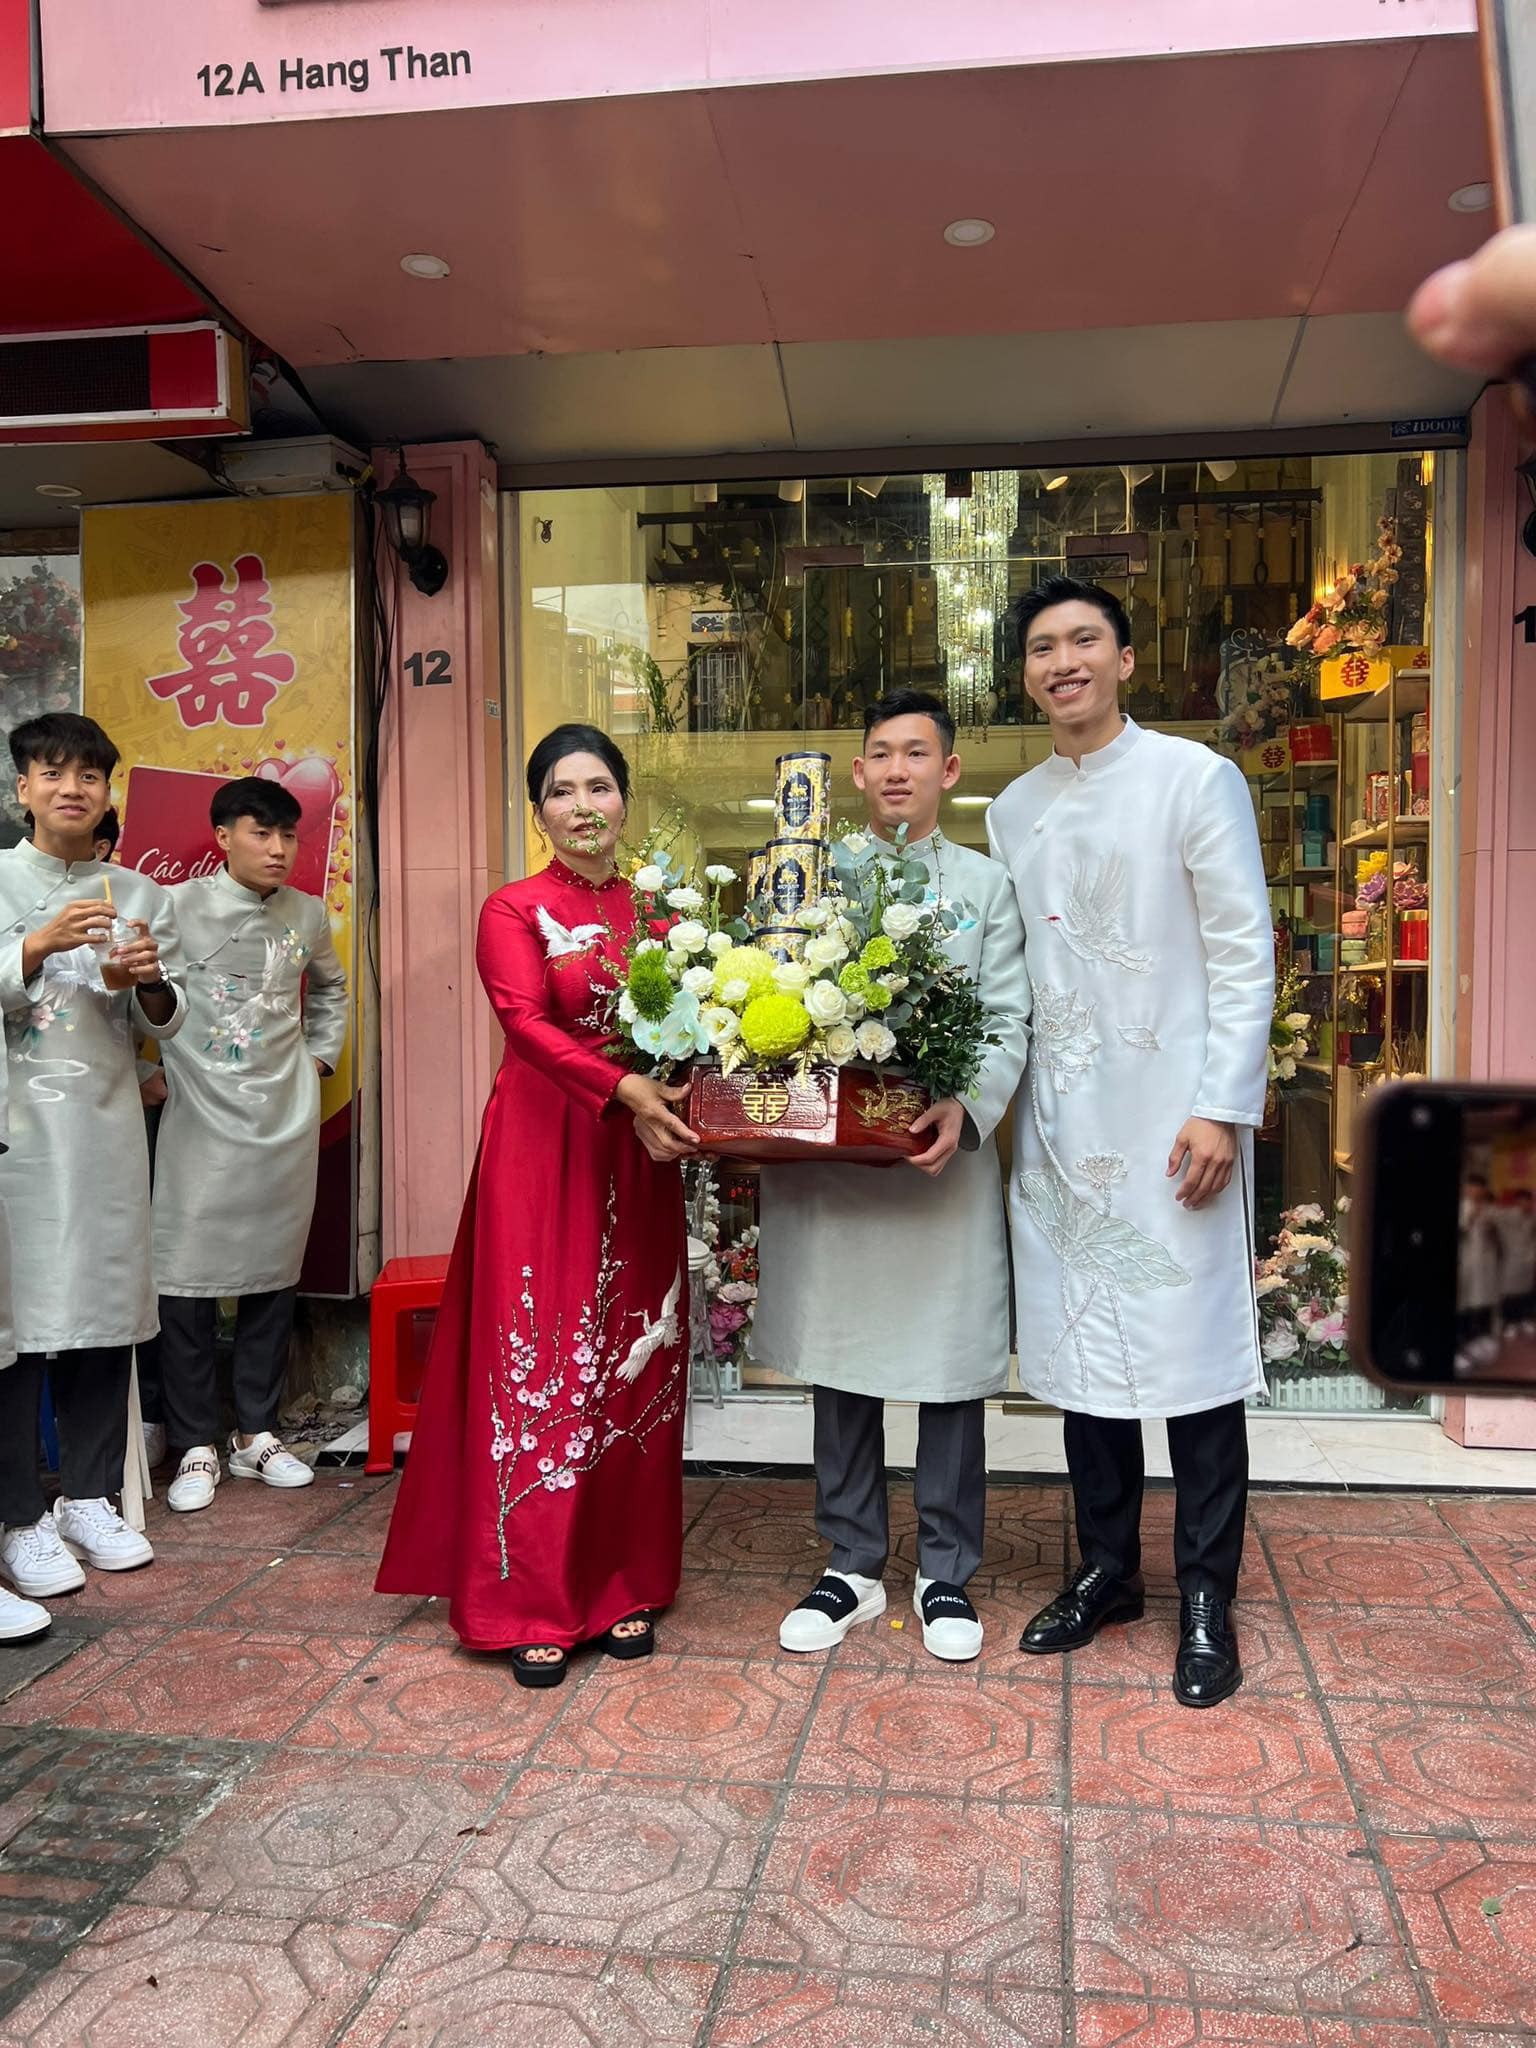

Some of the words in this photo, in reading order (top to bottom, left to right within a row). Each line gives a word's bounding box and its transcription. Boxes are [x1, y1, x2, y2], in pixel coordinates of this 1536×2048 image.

[197, 61, 265, 97] 12A
[279, 57, 369, 93] Hang
[380, 45, 472, 81] Than
[403, 650, 452, 687] 12
[135, 848, 185, 879] Các
